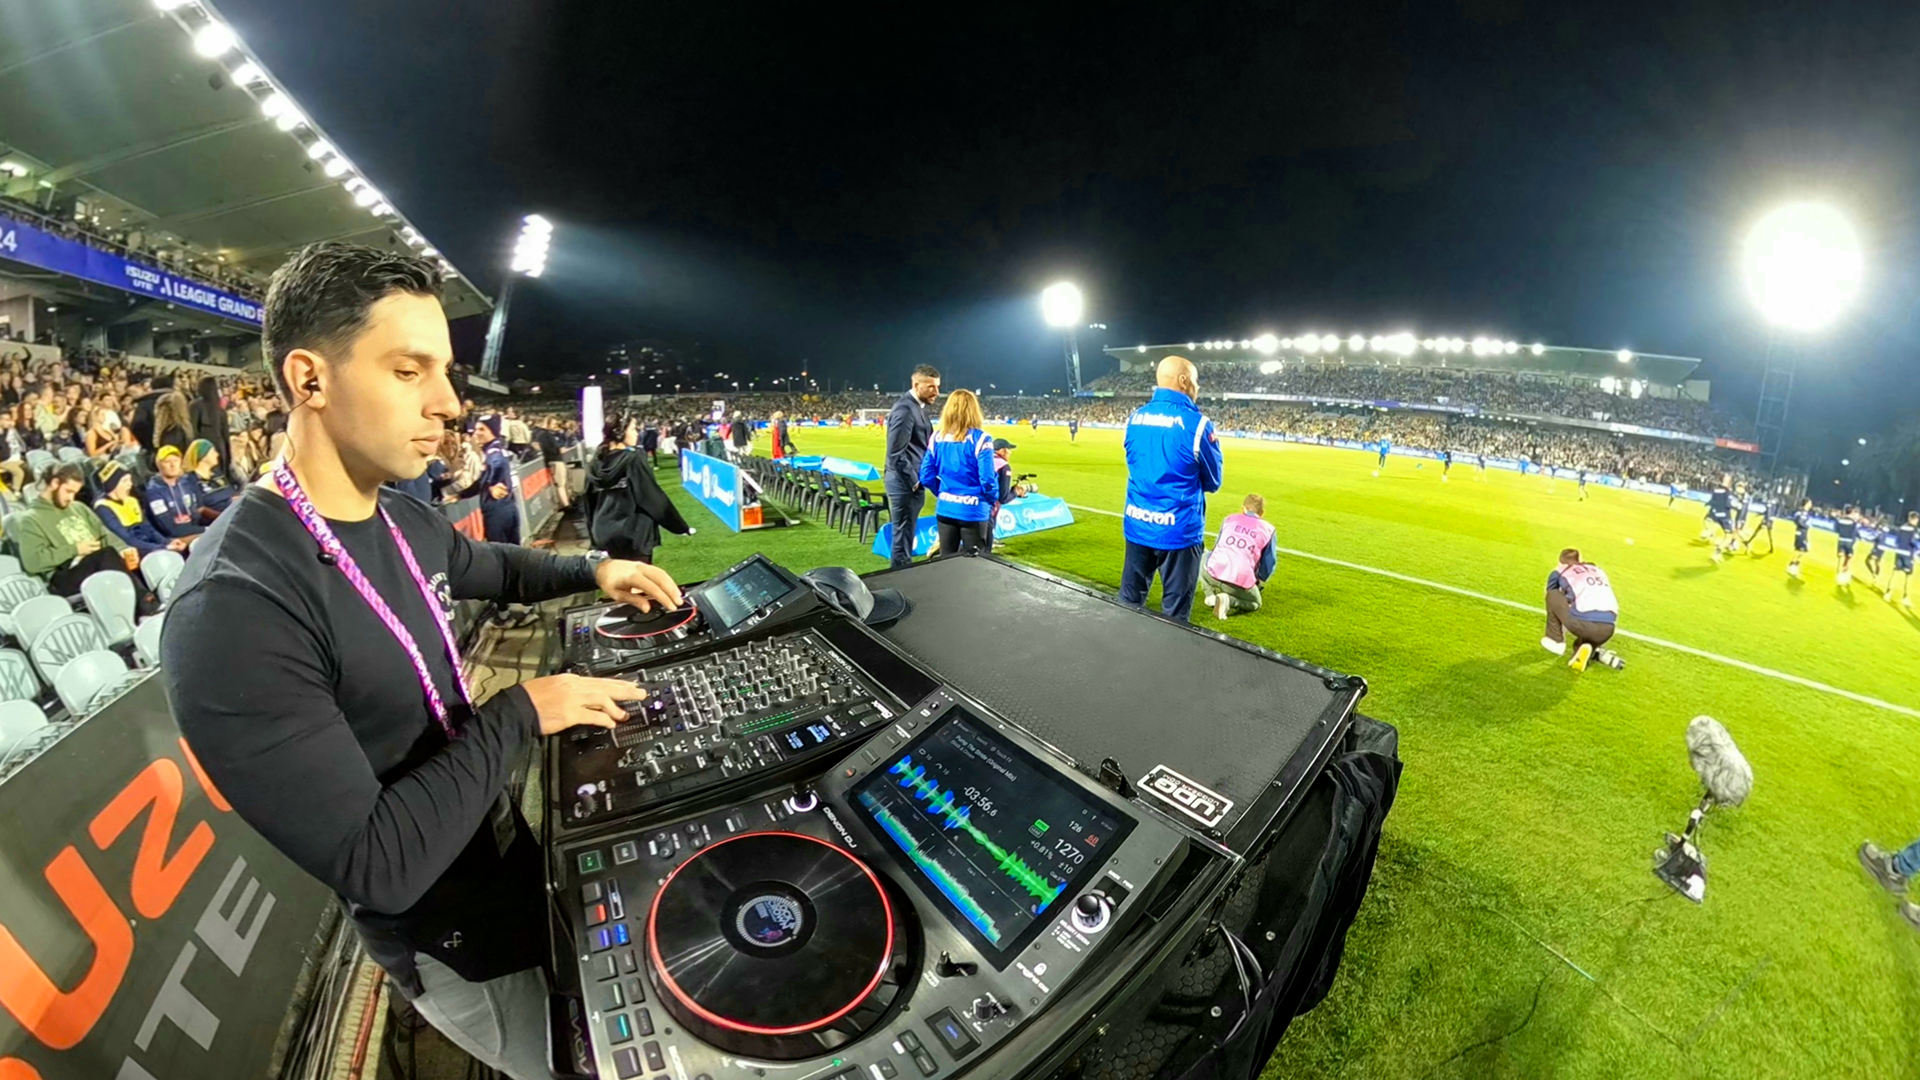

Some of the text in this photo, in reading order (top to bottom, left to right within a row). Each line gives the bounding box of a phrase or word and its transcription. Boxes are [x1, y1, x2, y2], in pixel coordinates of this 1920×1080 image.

[0, 230, 18, 252] 4
[125, 265, 160, 284] ISUZU
[174, 281, 217, 308] LEAGUE
[218, 296, 256, 320] GRAND
[1126, 504, 1175, 526] macron
[1234, 525, 1257, 539] ENG
[1226, 535, 1256, 555] 004
[428, 572, 447, 592] SAINT
[1586, 576, 1609, 588] 05
[954, 735, 969, 746] Pump
[985, 758, 1007, 774] (Original
[1003, 771, 1018, 781] Mix)
[963, 786, 998, 817] -03:56.6
[823, 807, 857, 848] DENON DJ
[1068, 821, 1083, 833] 126
[1029, 839, 1074, 874] +0.81% ±10
[1053, 839, 1086, 864] 1270
